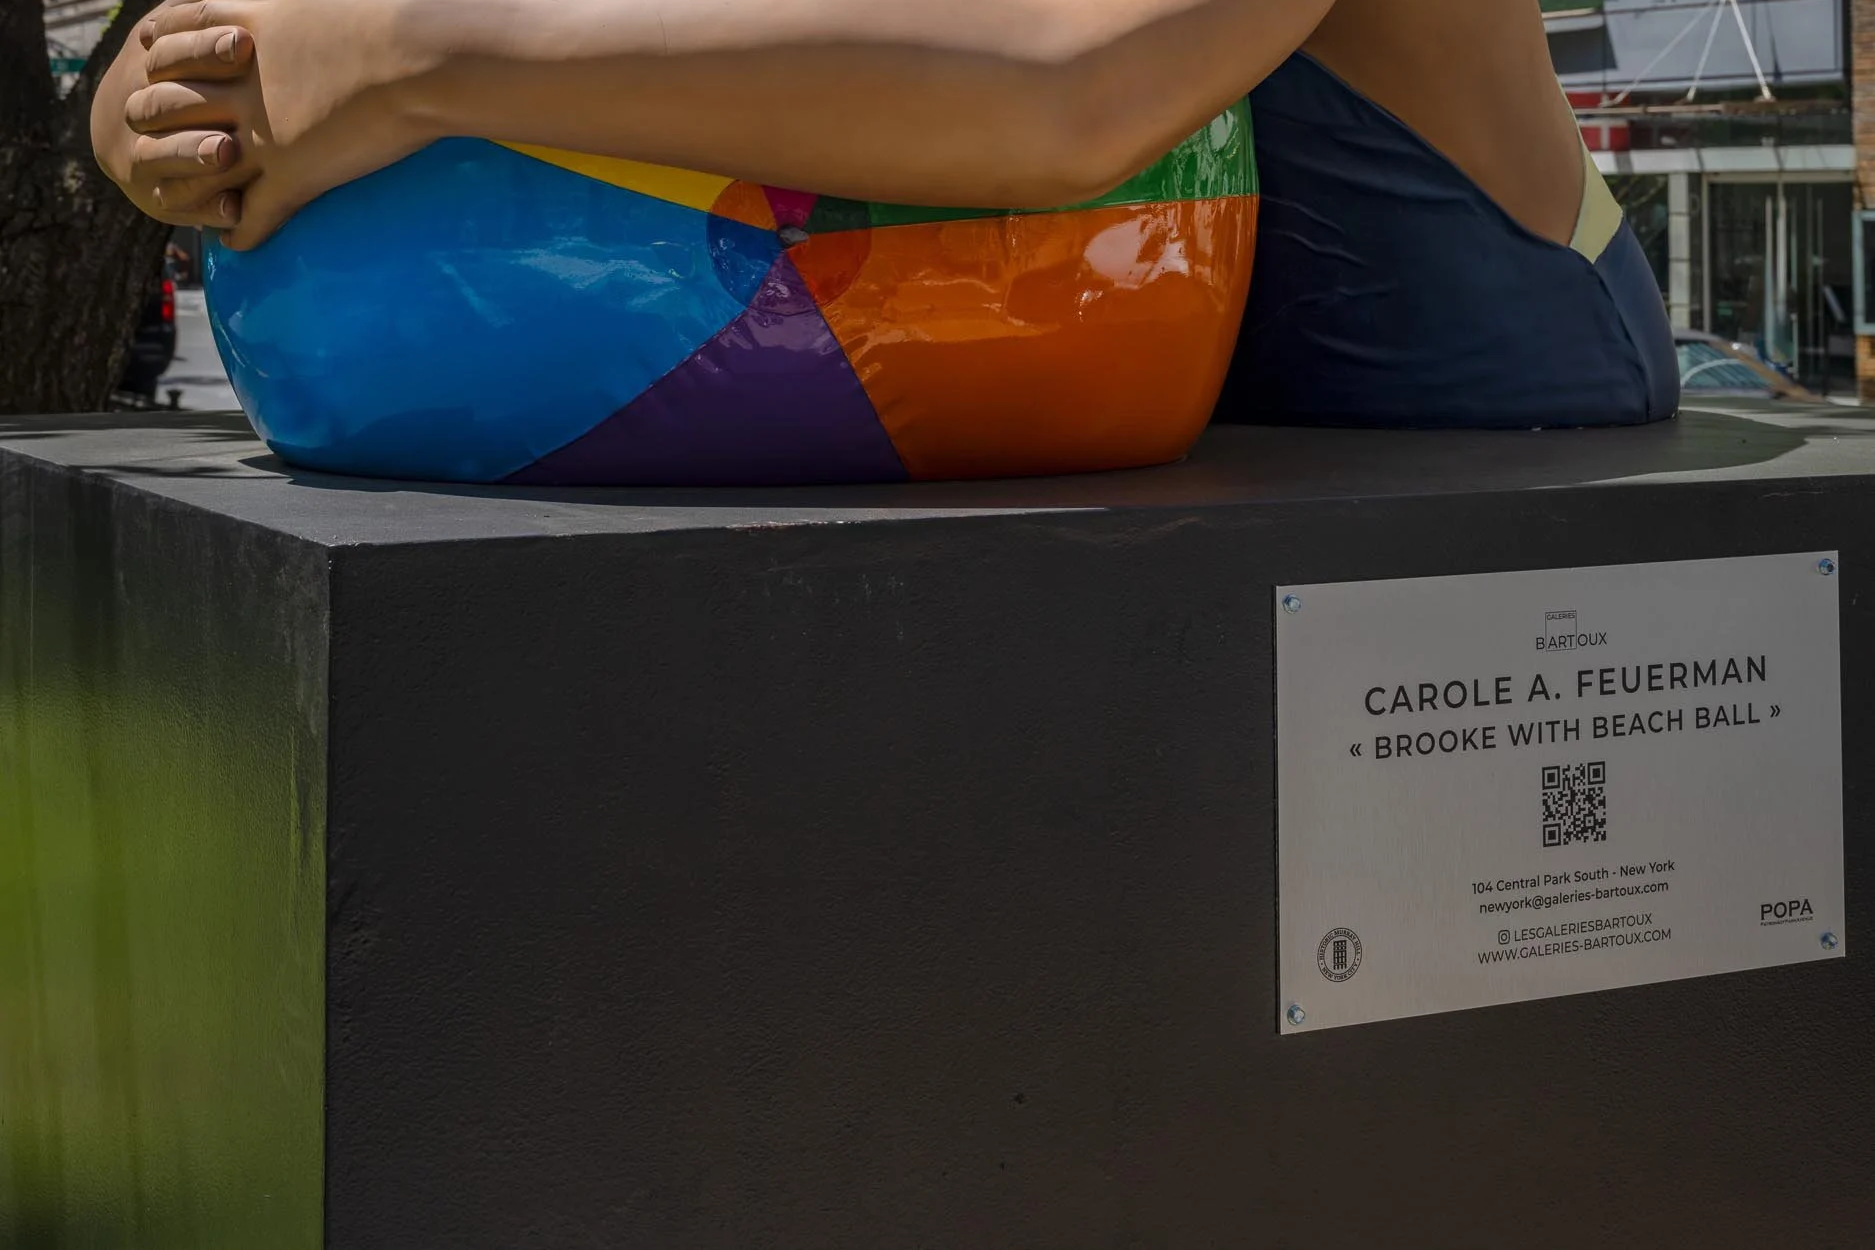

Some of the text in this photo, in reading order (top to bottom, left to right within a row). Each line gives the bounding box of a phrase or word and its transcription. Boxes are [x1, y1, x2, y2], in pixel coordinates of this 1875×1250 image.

[1546, 612, 1576, 621] GALERIES
[1536, 632, 1607, 650] BARTOUX
[1364, 655, 1766, 716] CAROLE A. FEUERMAN
[1375, 726, 1497, 760] BROOKE
[1507, 718, 1580, 747] WITH
[1593, 709, 1683, 739] BEACH
[1695, 702, 1761, 729] BALL
[1472, 881, 1493, 895] 104
[1496, 875, 1540, 892] Central
[1543, 872, 1571, 886] Park
[1574, 867, 1609, 883] South
[1620, 865, 1646, 878] New
[1648, 859, 1676, 873] York
[1479, 880, 1669, 914] newyork@galeries-bartoux.com
[1760, 899, 1813, 921] POPA
[1514, 913, 1653, 942] LESGALERIESBARTOUX
[1478, 928, 1672, 964] WWW.GALERIES-BARTOUX.COM
